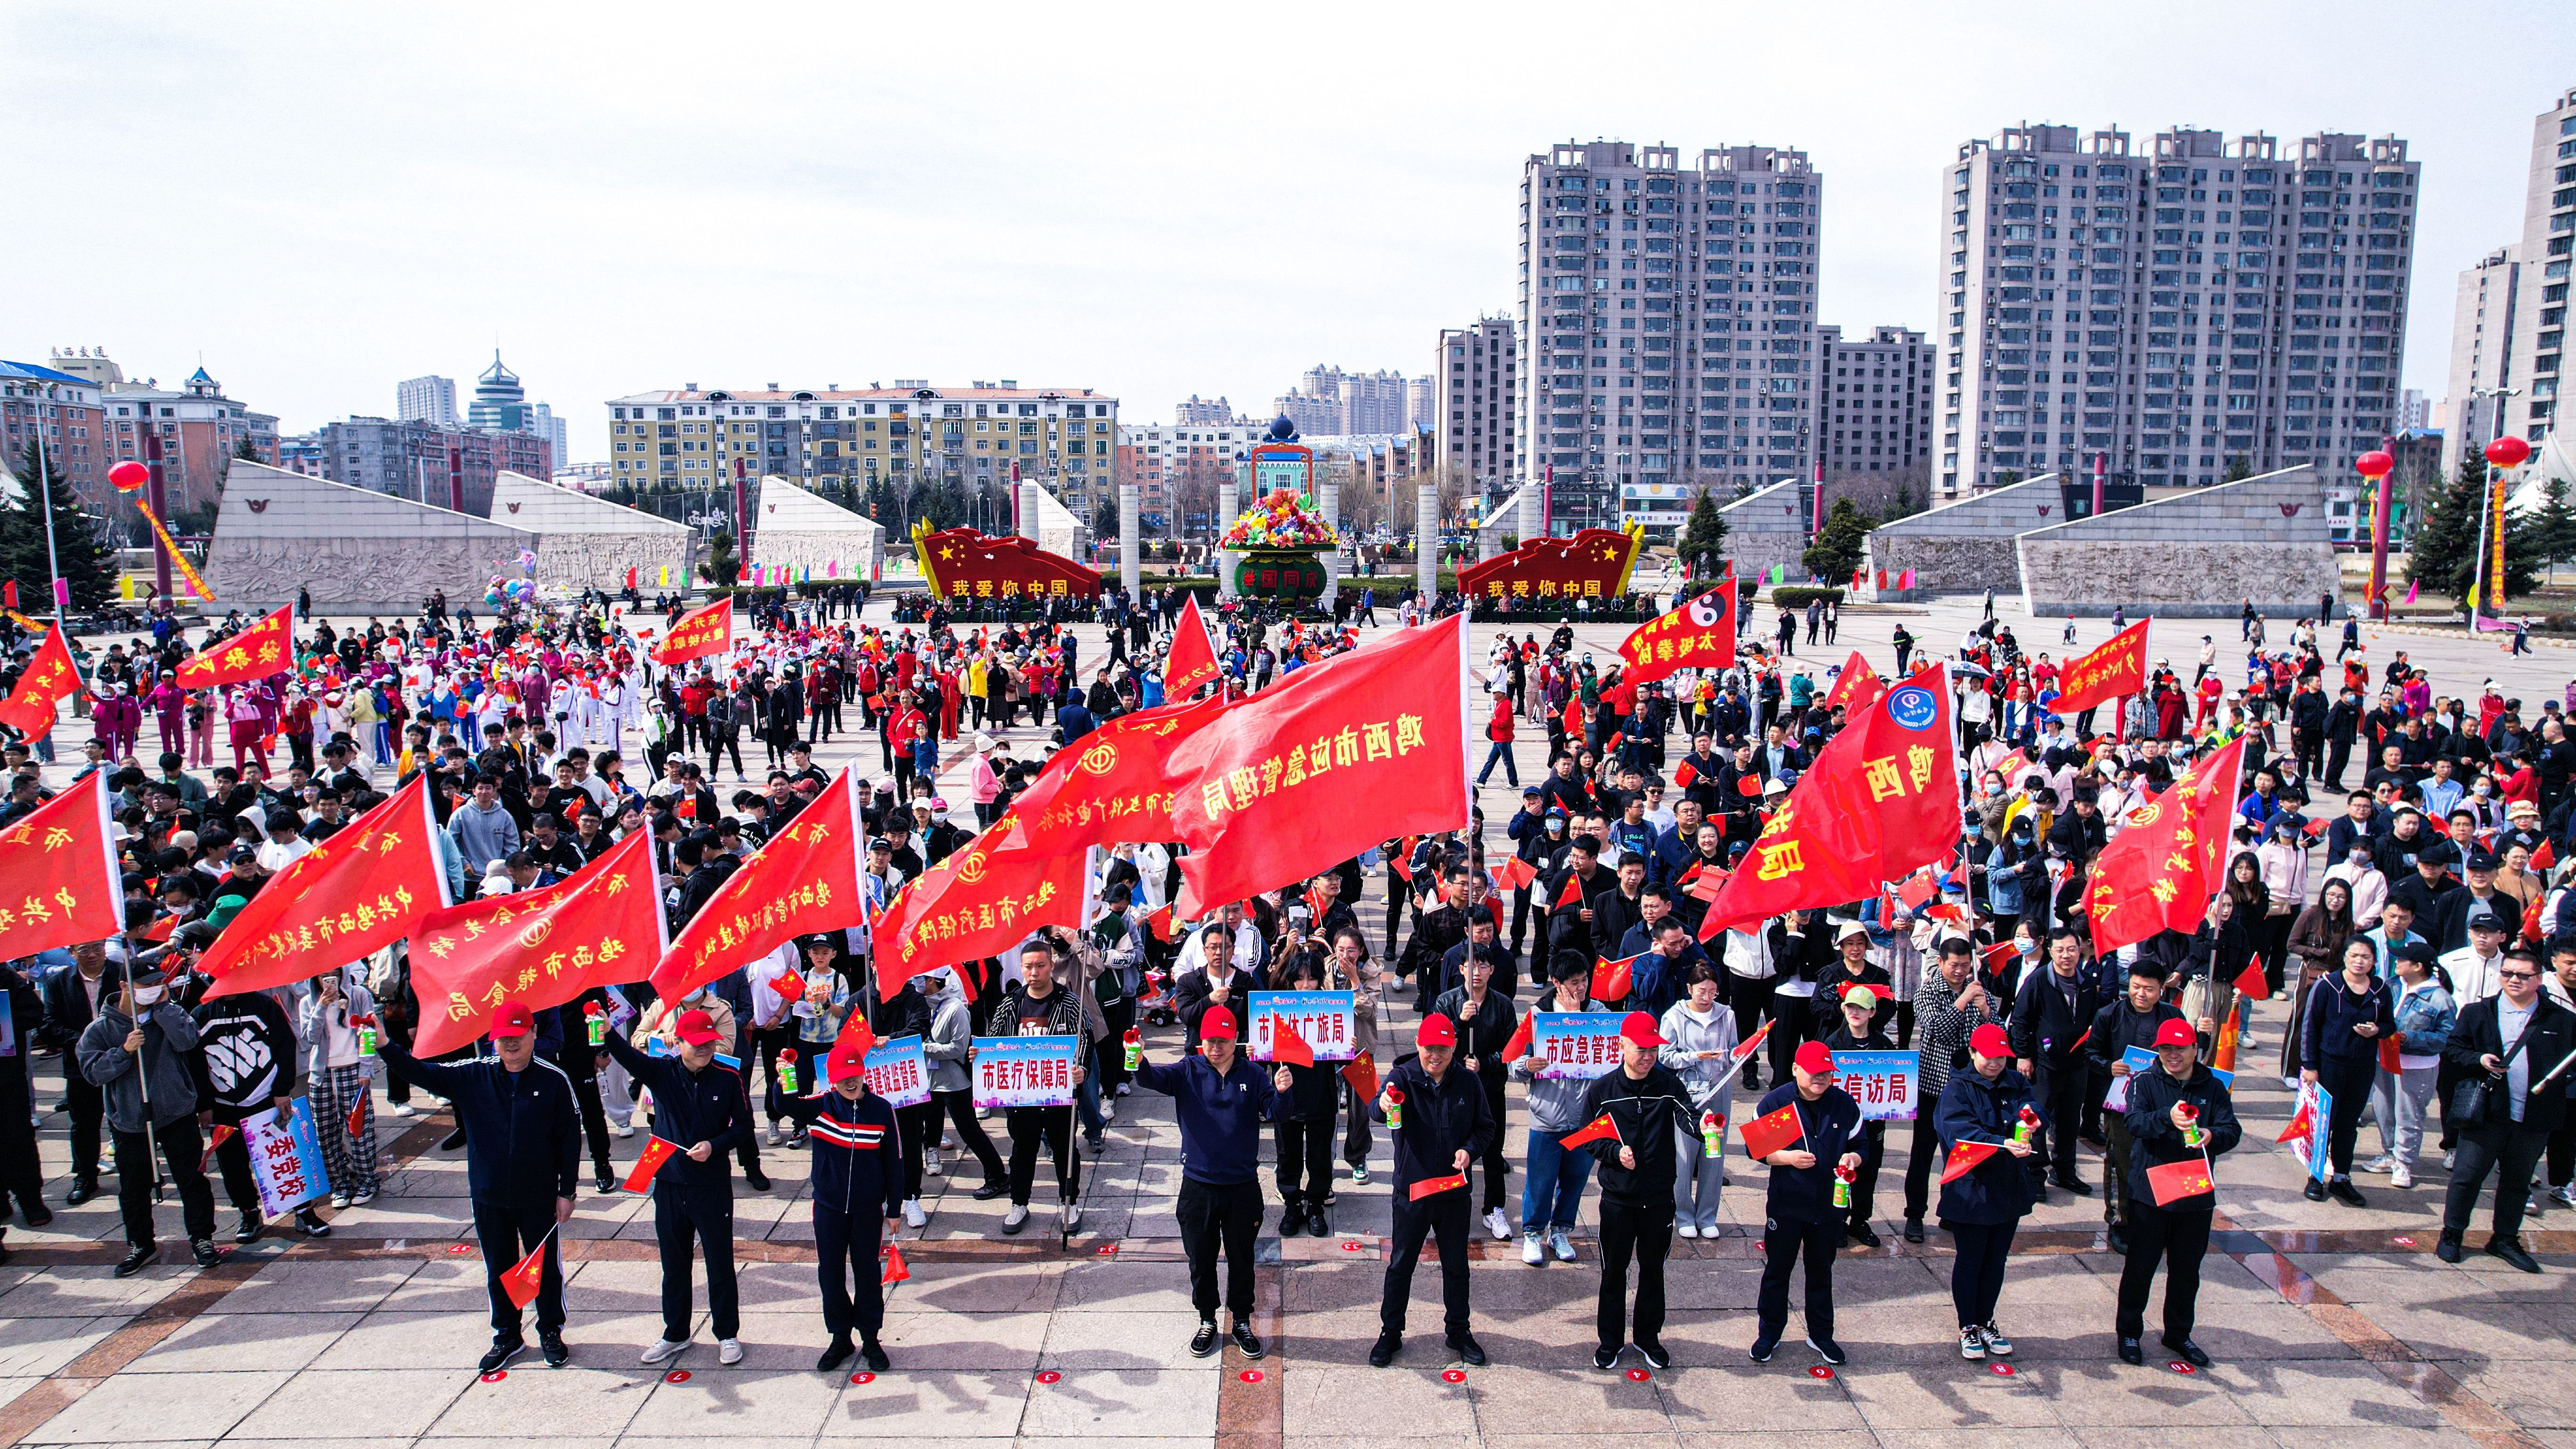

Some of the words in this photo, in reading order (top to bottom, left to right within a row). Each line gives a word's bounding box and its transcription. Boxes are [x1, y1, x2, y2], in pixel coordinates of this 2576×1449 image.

[952, 580, 1068, 596] 我爱你中国
[1243, 570, 1318, 589] 举国同庆
[1488, 580, 1602, 597] 我爱你中国
[1258, 1012, 1344, 1045] 市体广旅局
[1545, 1034, 1620, 1064] 市应急管理
[982, 1058, 1068, 1091] 市医疗保障局
[1342, 1243, 1359, 1251] 33
[489, 1372, 500, 1380] 9
[2172, 1363, 2190, 1372] 10
